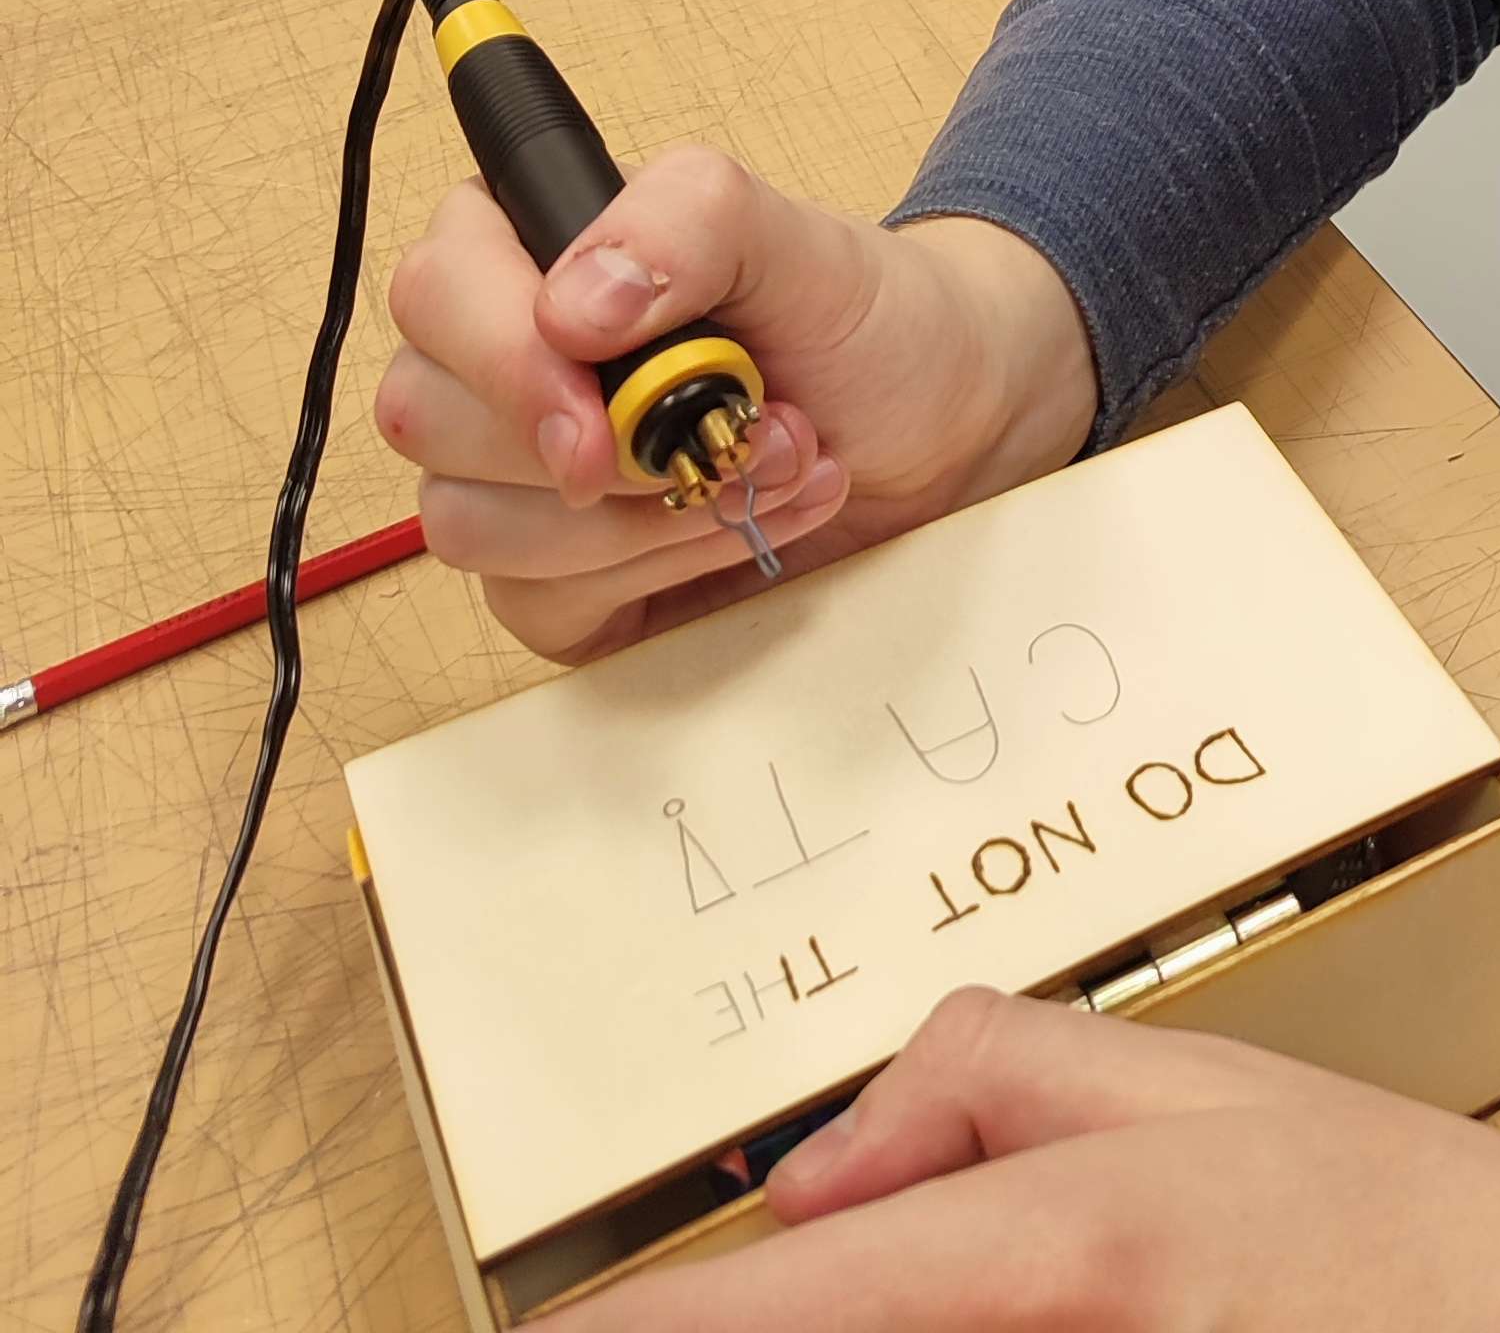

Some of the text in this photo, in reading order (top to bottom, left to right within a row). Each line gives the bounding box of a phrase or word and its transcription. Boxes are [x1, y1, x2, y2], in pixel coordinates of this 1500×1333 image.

[693, 727, 1267, 1045] DO NOT THE
